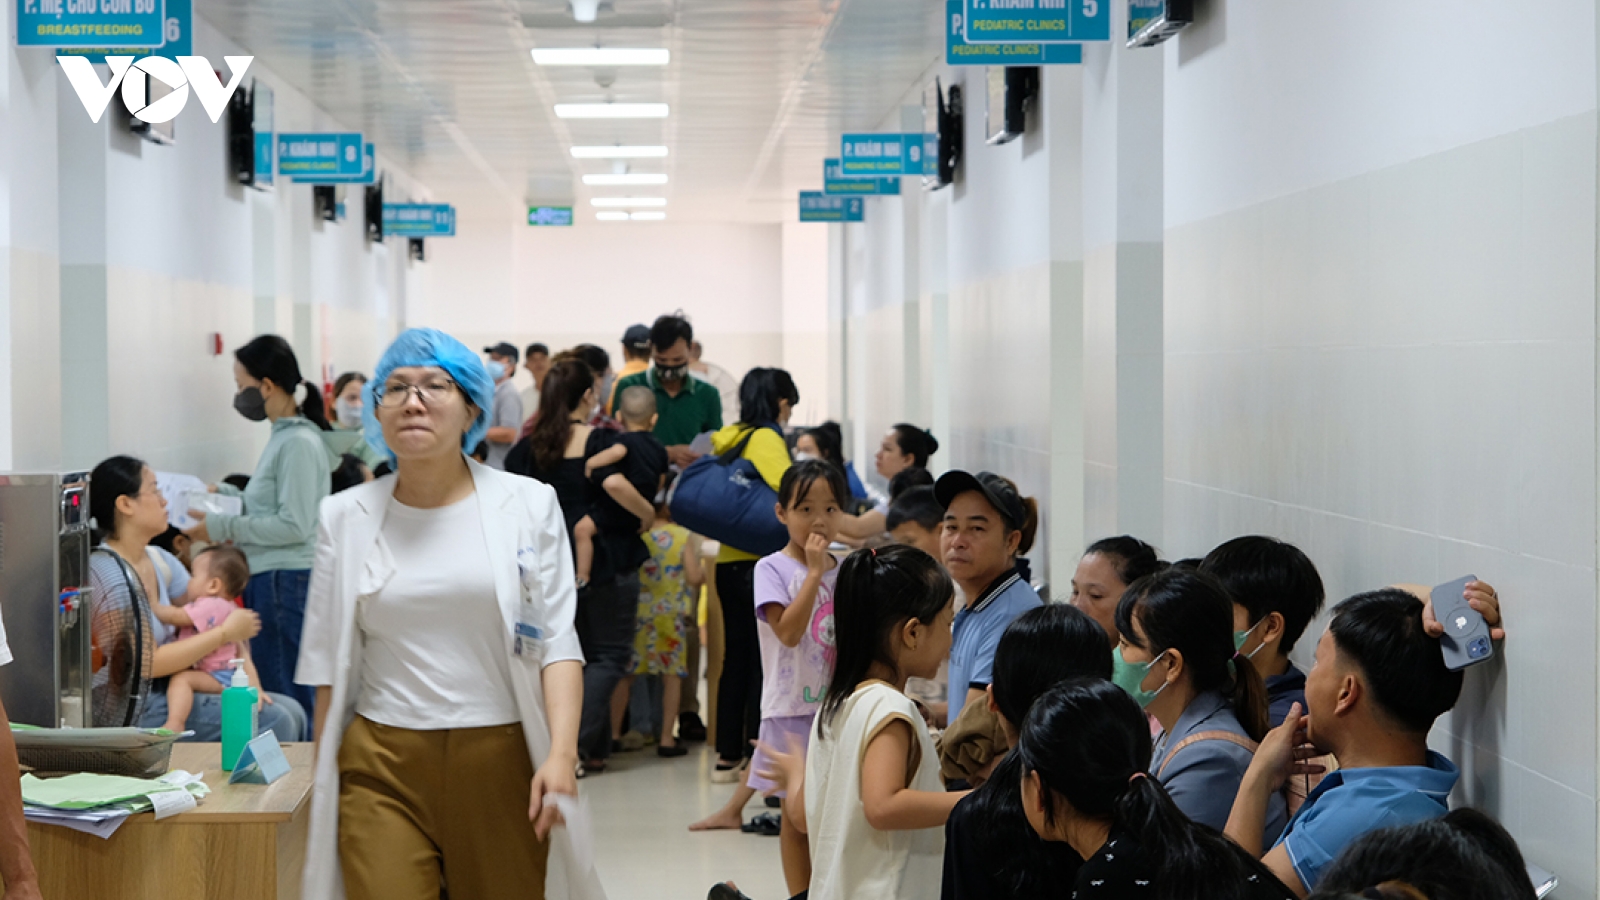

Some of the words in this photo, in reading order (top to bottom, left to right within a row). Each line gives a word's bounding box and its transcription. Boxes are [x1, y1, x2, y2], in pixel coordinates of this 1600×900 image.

[1082, 0, 1098, 18] 5
[37, 24, 143, 36] BREASTFEEDING
[165, 17, 180, 42] 6
[973, 19, 1024, 31] PEDIATRIC
[1026, 19, 1066, 31] CLINICS
[952, 44, 1000, 56] PEDIATRIC
[1002, 43, 1040, 55] CLINICS
[910, 145, 921, 162] 9
